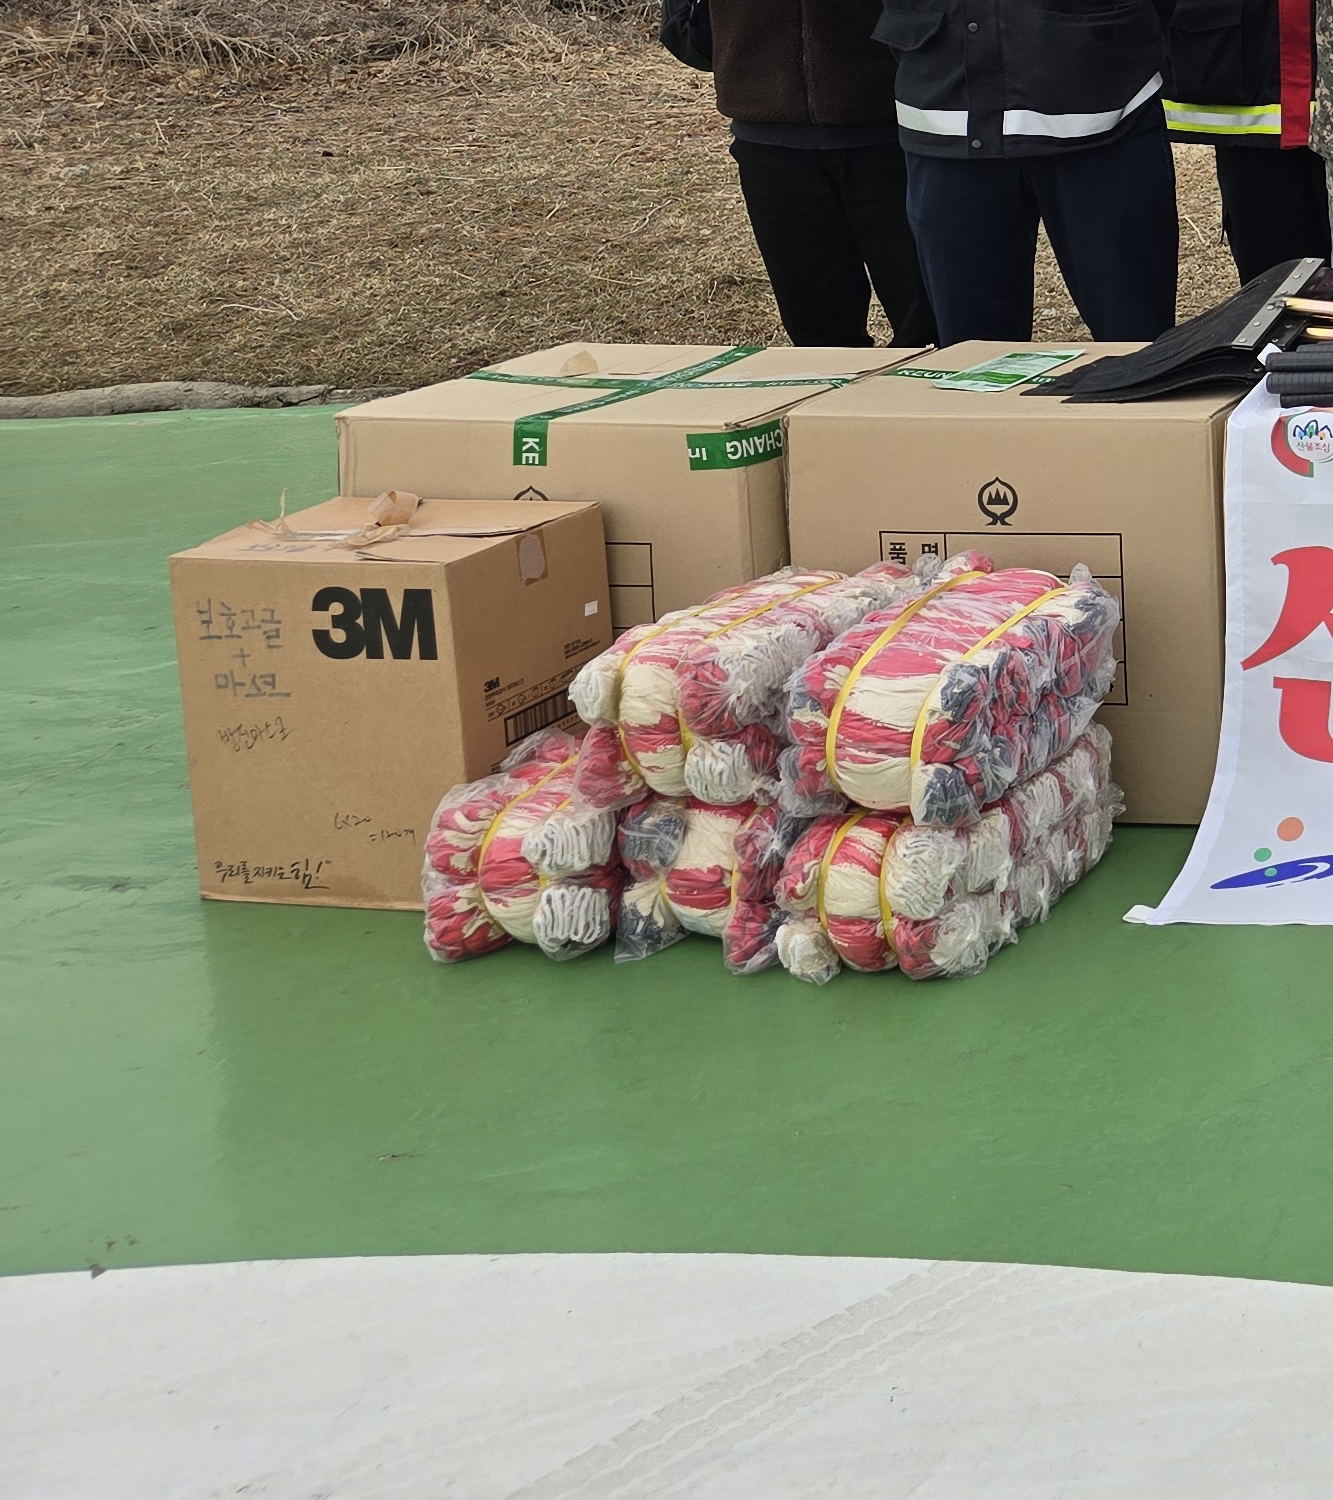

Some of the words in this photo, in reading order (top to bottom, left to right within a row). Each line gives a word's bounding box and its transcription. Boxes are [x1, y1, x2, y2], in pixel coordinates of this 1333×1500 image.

[522, 437, 540, 465] KE
[196, 597, 284, 649] 보호고글
[311, 586, 438, 661] 3M
[214, 670, 292, 698] 마스크
[484, 677, 500, 693] 3M
